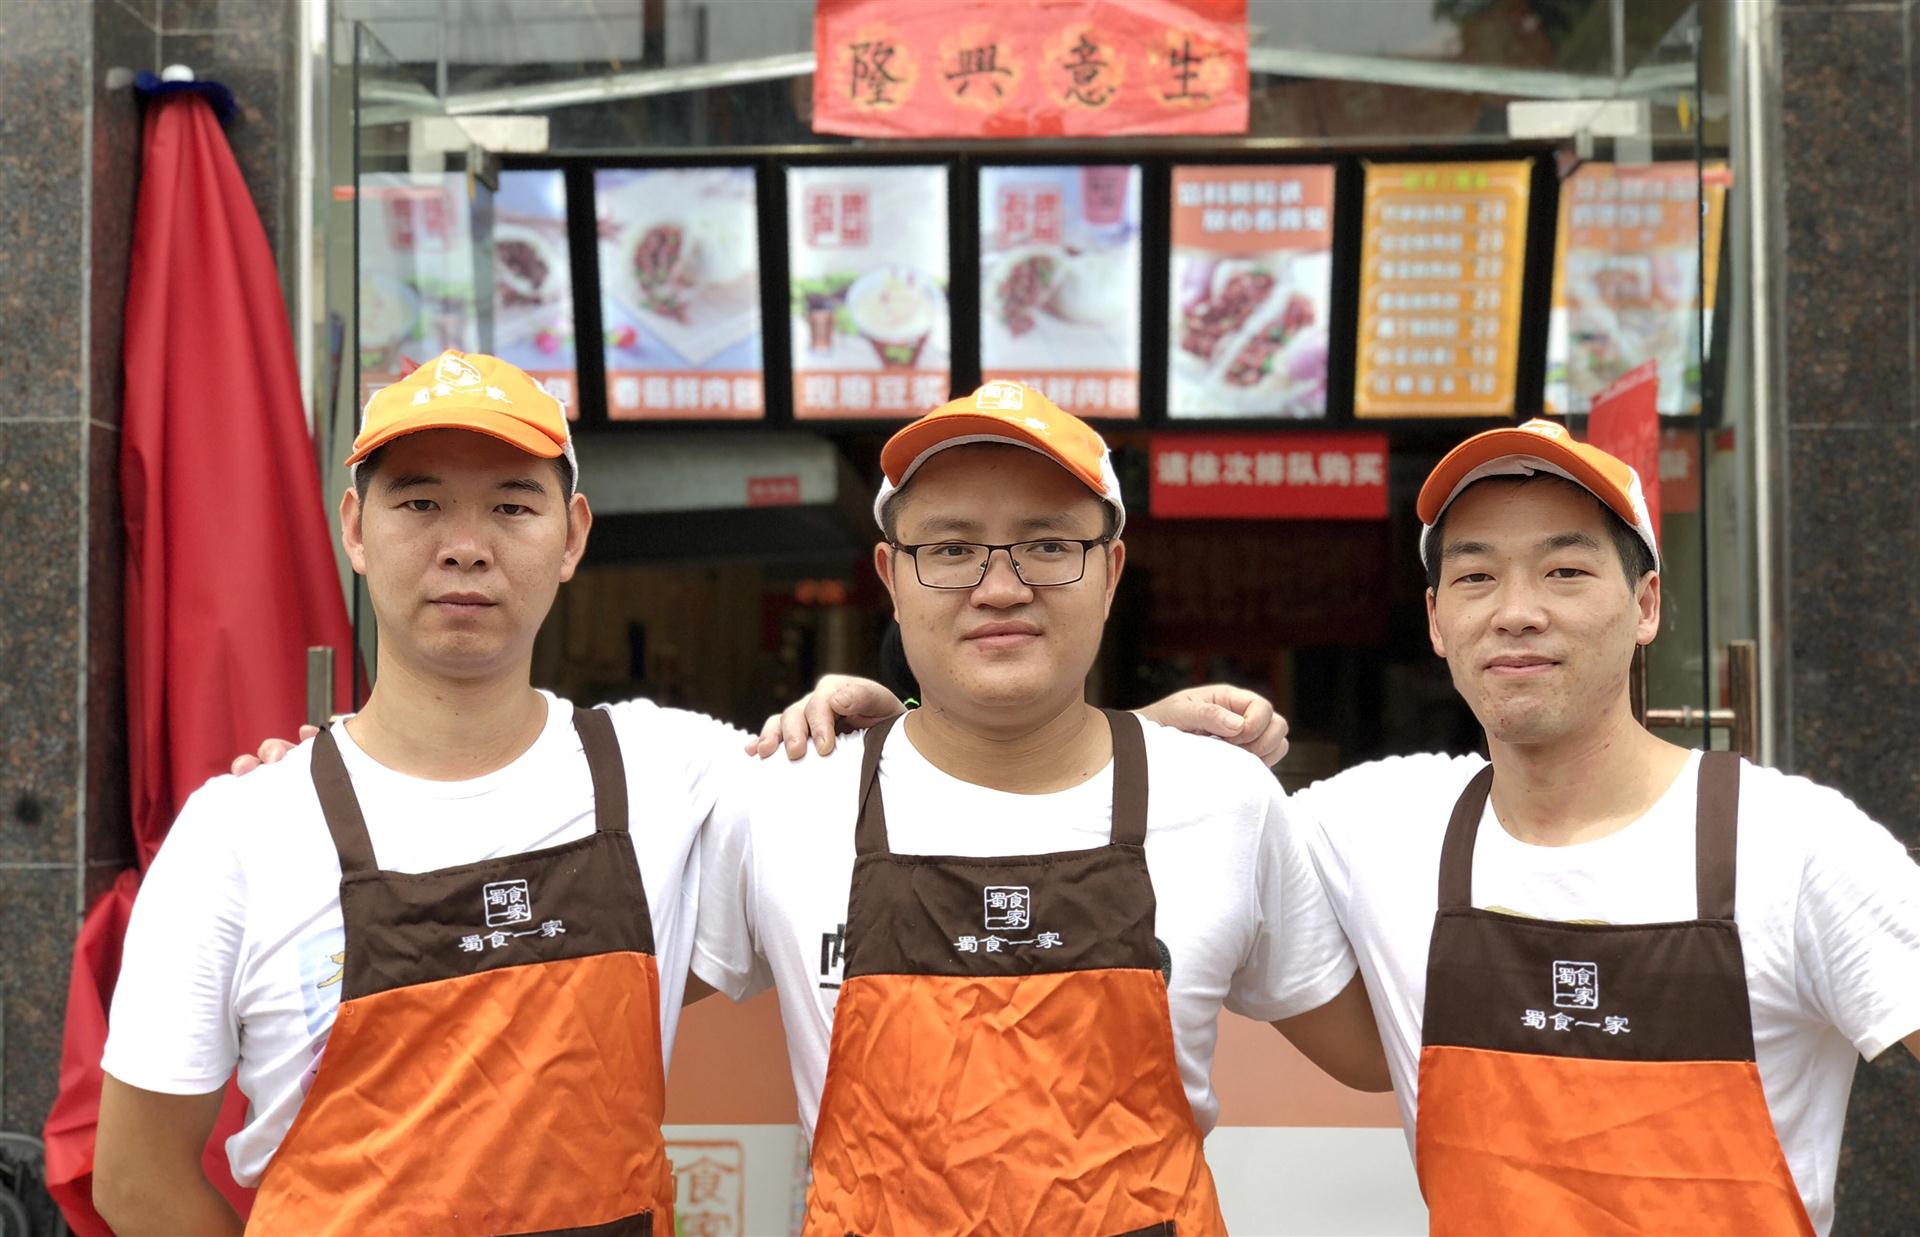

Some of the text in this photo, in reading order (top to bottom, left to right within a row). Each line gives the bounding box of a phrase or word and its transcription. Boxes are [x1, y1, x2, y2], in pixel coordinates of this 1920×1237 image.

[1157, 451, 1385, 486] 请依次排队购买
[458, 919, 566, 952] 蜀食一家
[954, 931, 1063, 953] 蜀食一家
[1521, 1008, 1631, 1035] 蜀食一家
